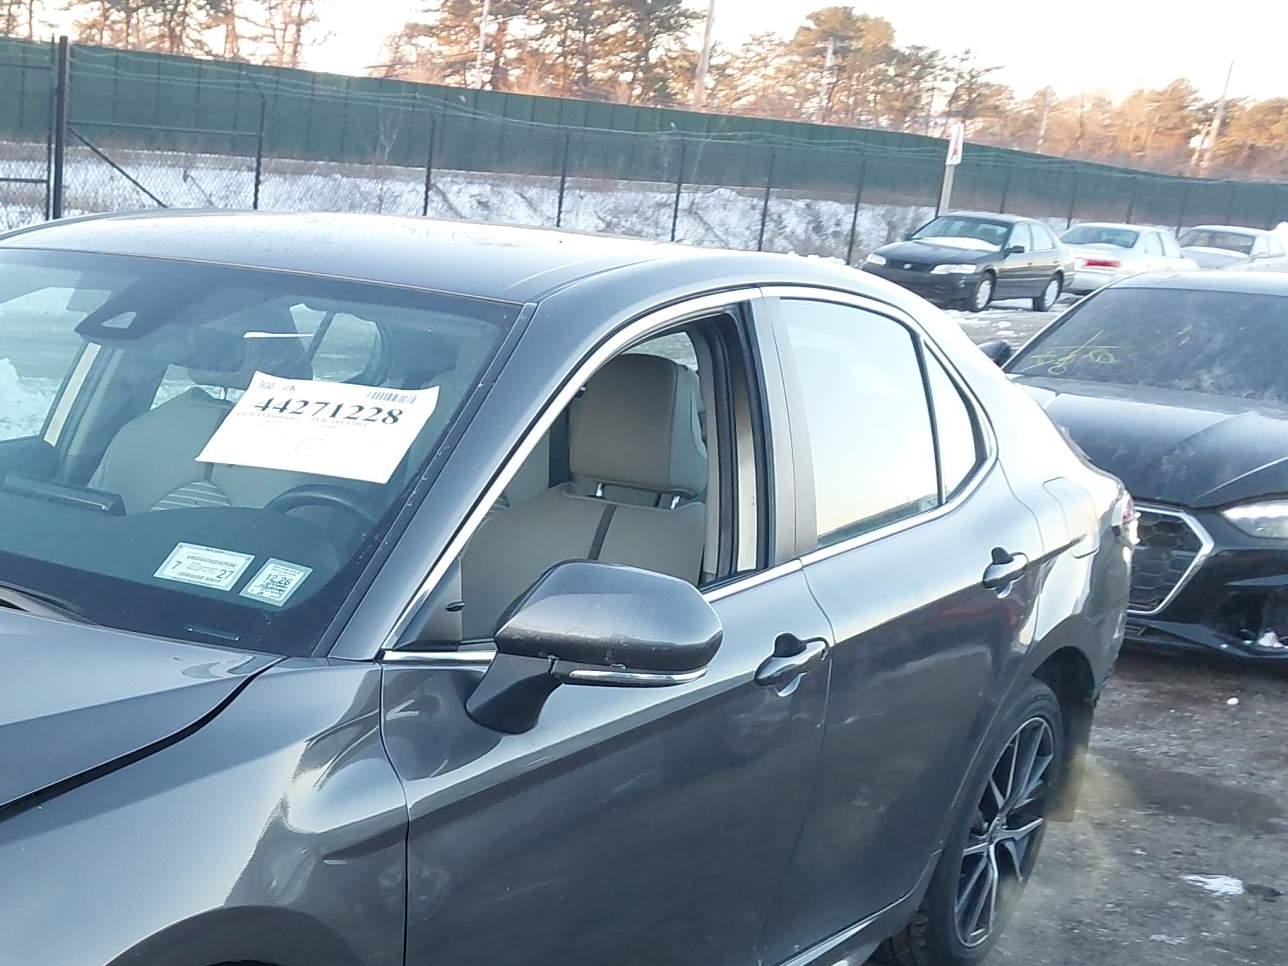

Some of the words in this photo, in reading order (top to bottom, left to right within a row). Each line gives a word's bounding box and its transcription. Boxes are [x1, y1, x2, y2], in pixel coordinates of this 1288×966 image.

[253, 397, 404, 425] 44271228
[171, 560, 182, 570] 7
[215, 568, 235, 580] 27
